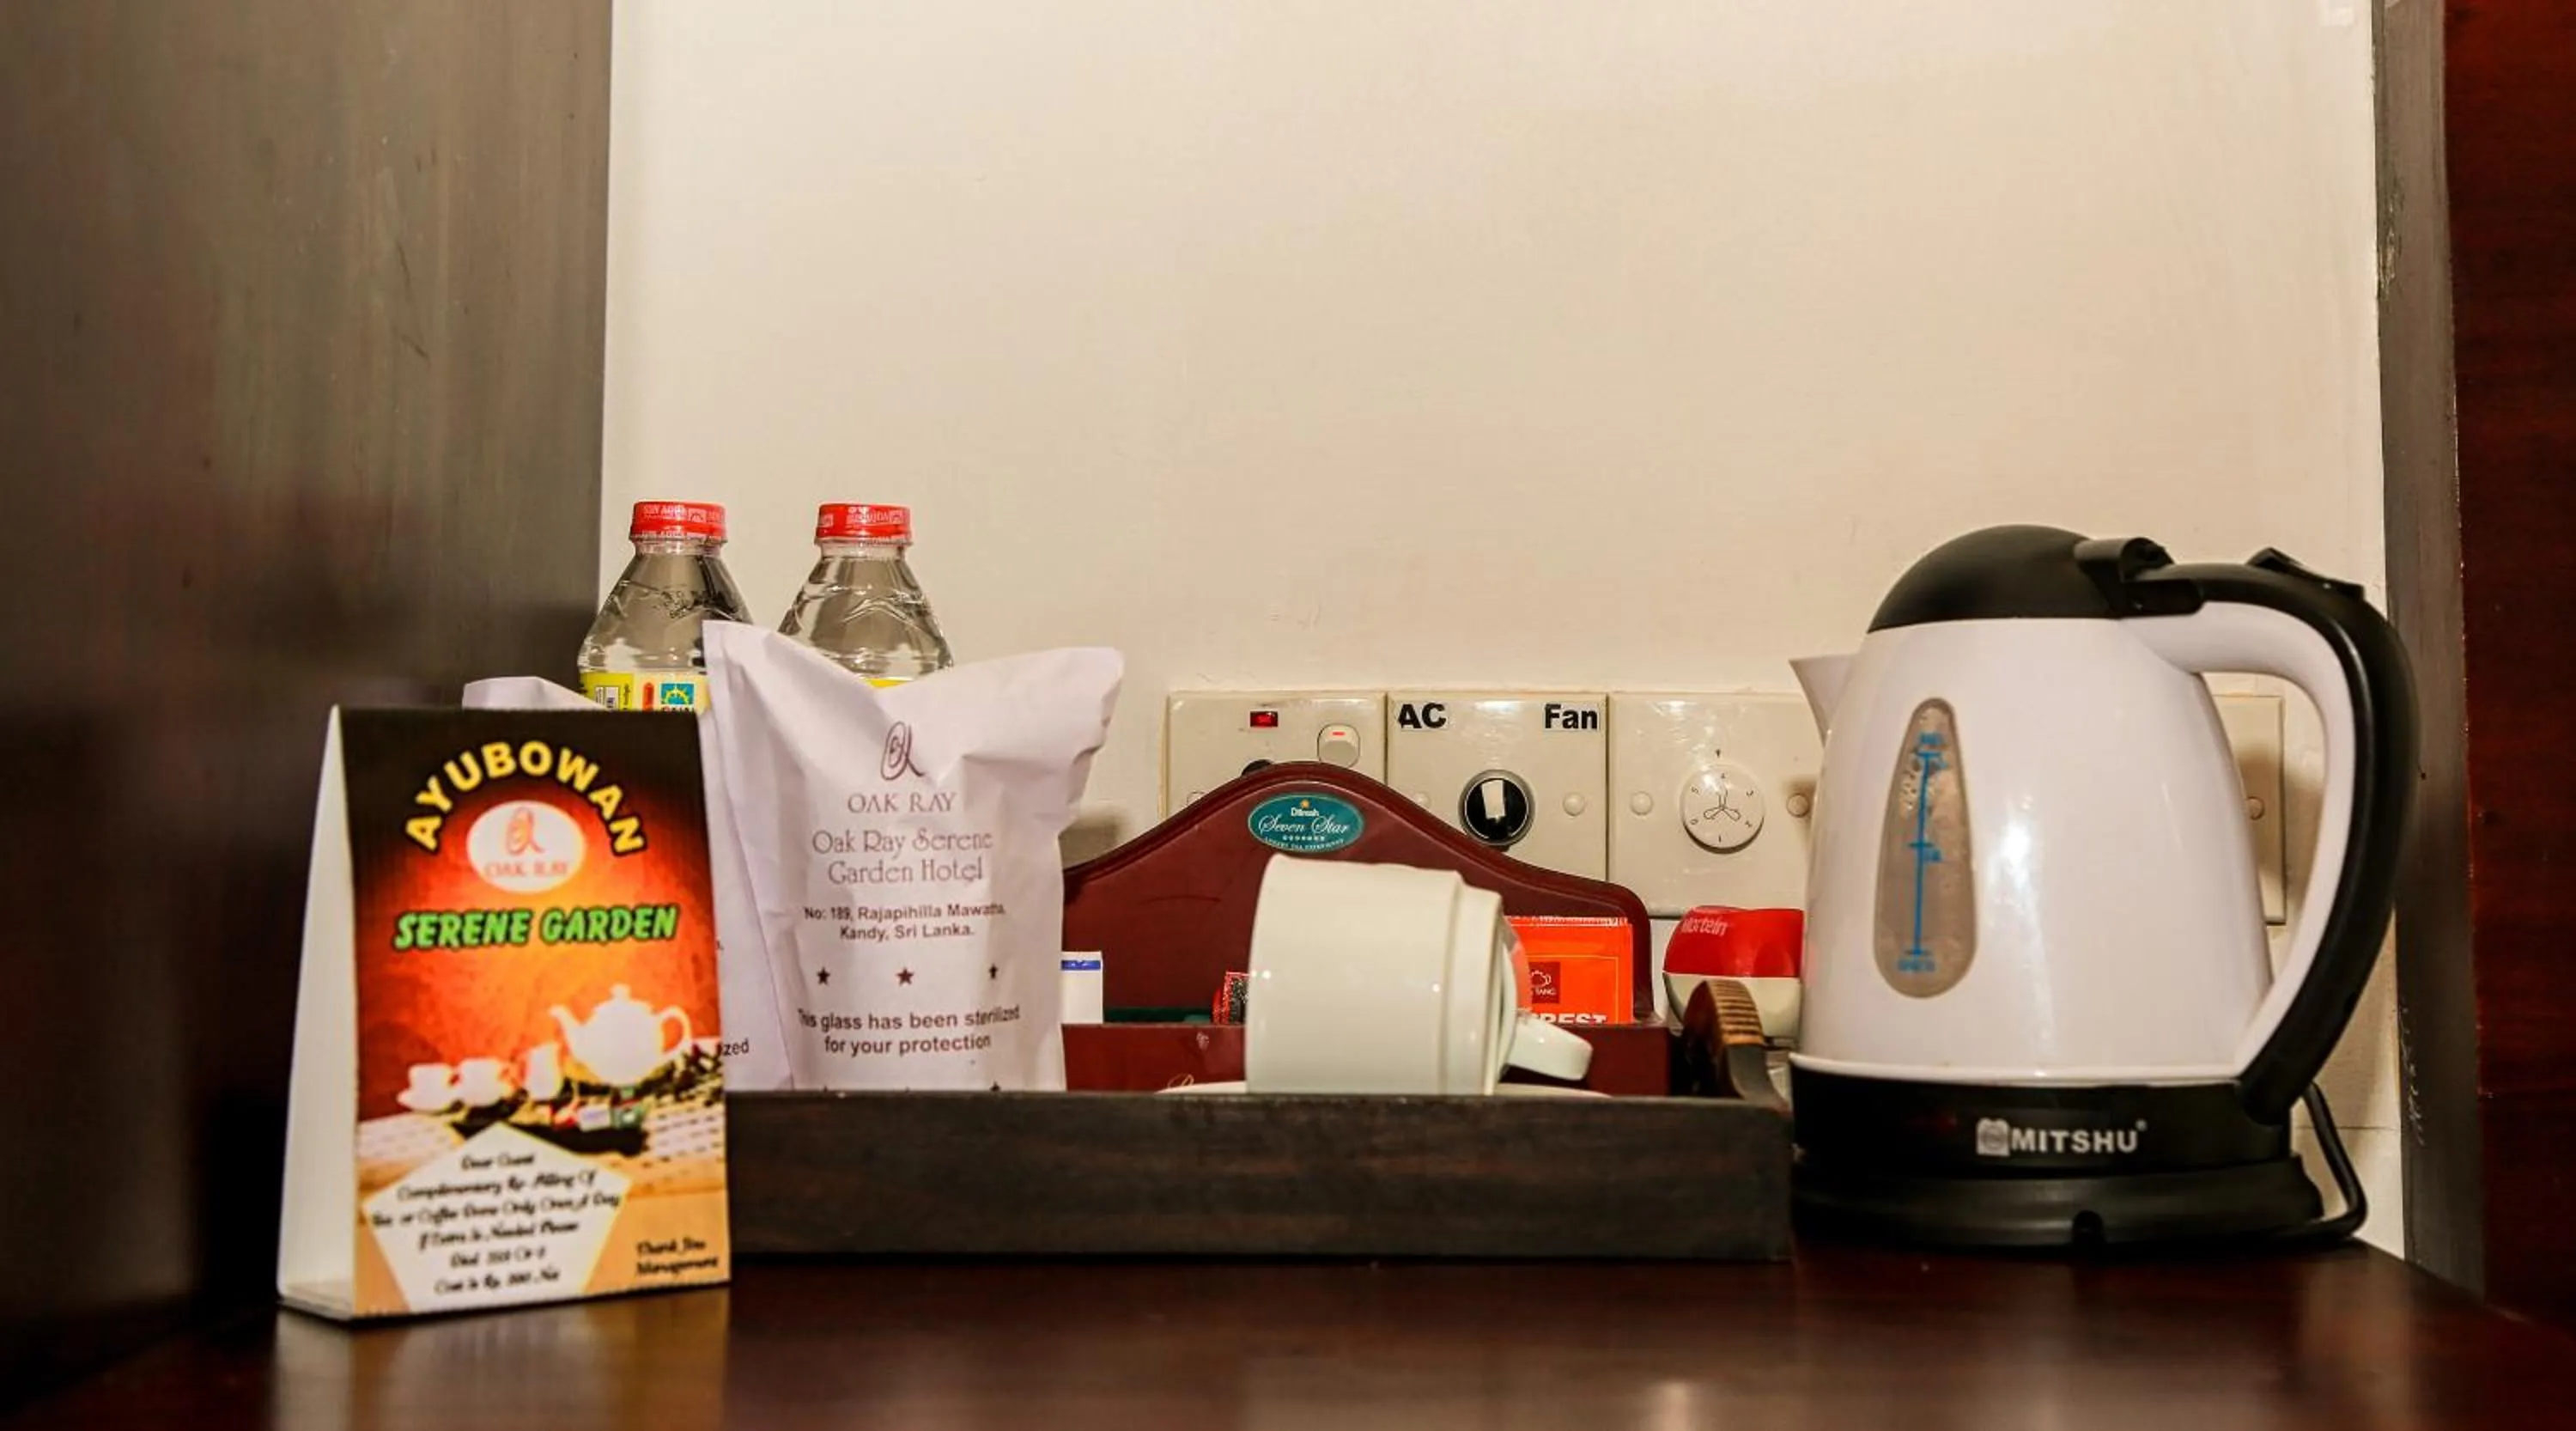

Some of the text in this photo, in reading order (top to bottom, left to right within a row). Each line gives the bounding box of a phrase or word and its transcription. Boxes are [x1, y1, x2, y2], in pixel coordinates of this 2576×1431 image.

[1397, 703, 1597, 729] AC Fan
[405, 741, 645, 855] AYUBOWAN
[848, 792, 957, 813] OAK RAY
[1258, 814, 1350, 836] Seven Star
[812, 827, 993, 859] Oak Ray Serene
[828, 856, 983, 885] Garden Hotel
[805, 908, 827, 920] No:
[858, 904, 943, 923] Rajapihilla
[395, 904, 679, 950] SERENE GARDEN
[840, 923, 975, 941] Kandy, Sri Lanka.
[821, 1013, 862, 1032] glass
[868, 1013, 902, 1030] has
[909, 1011, 957, 1030] been
[824, 1033, 991, 1057] for your protection
[2011, 1127, 2138, 1154] MITSHU
